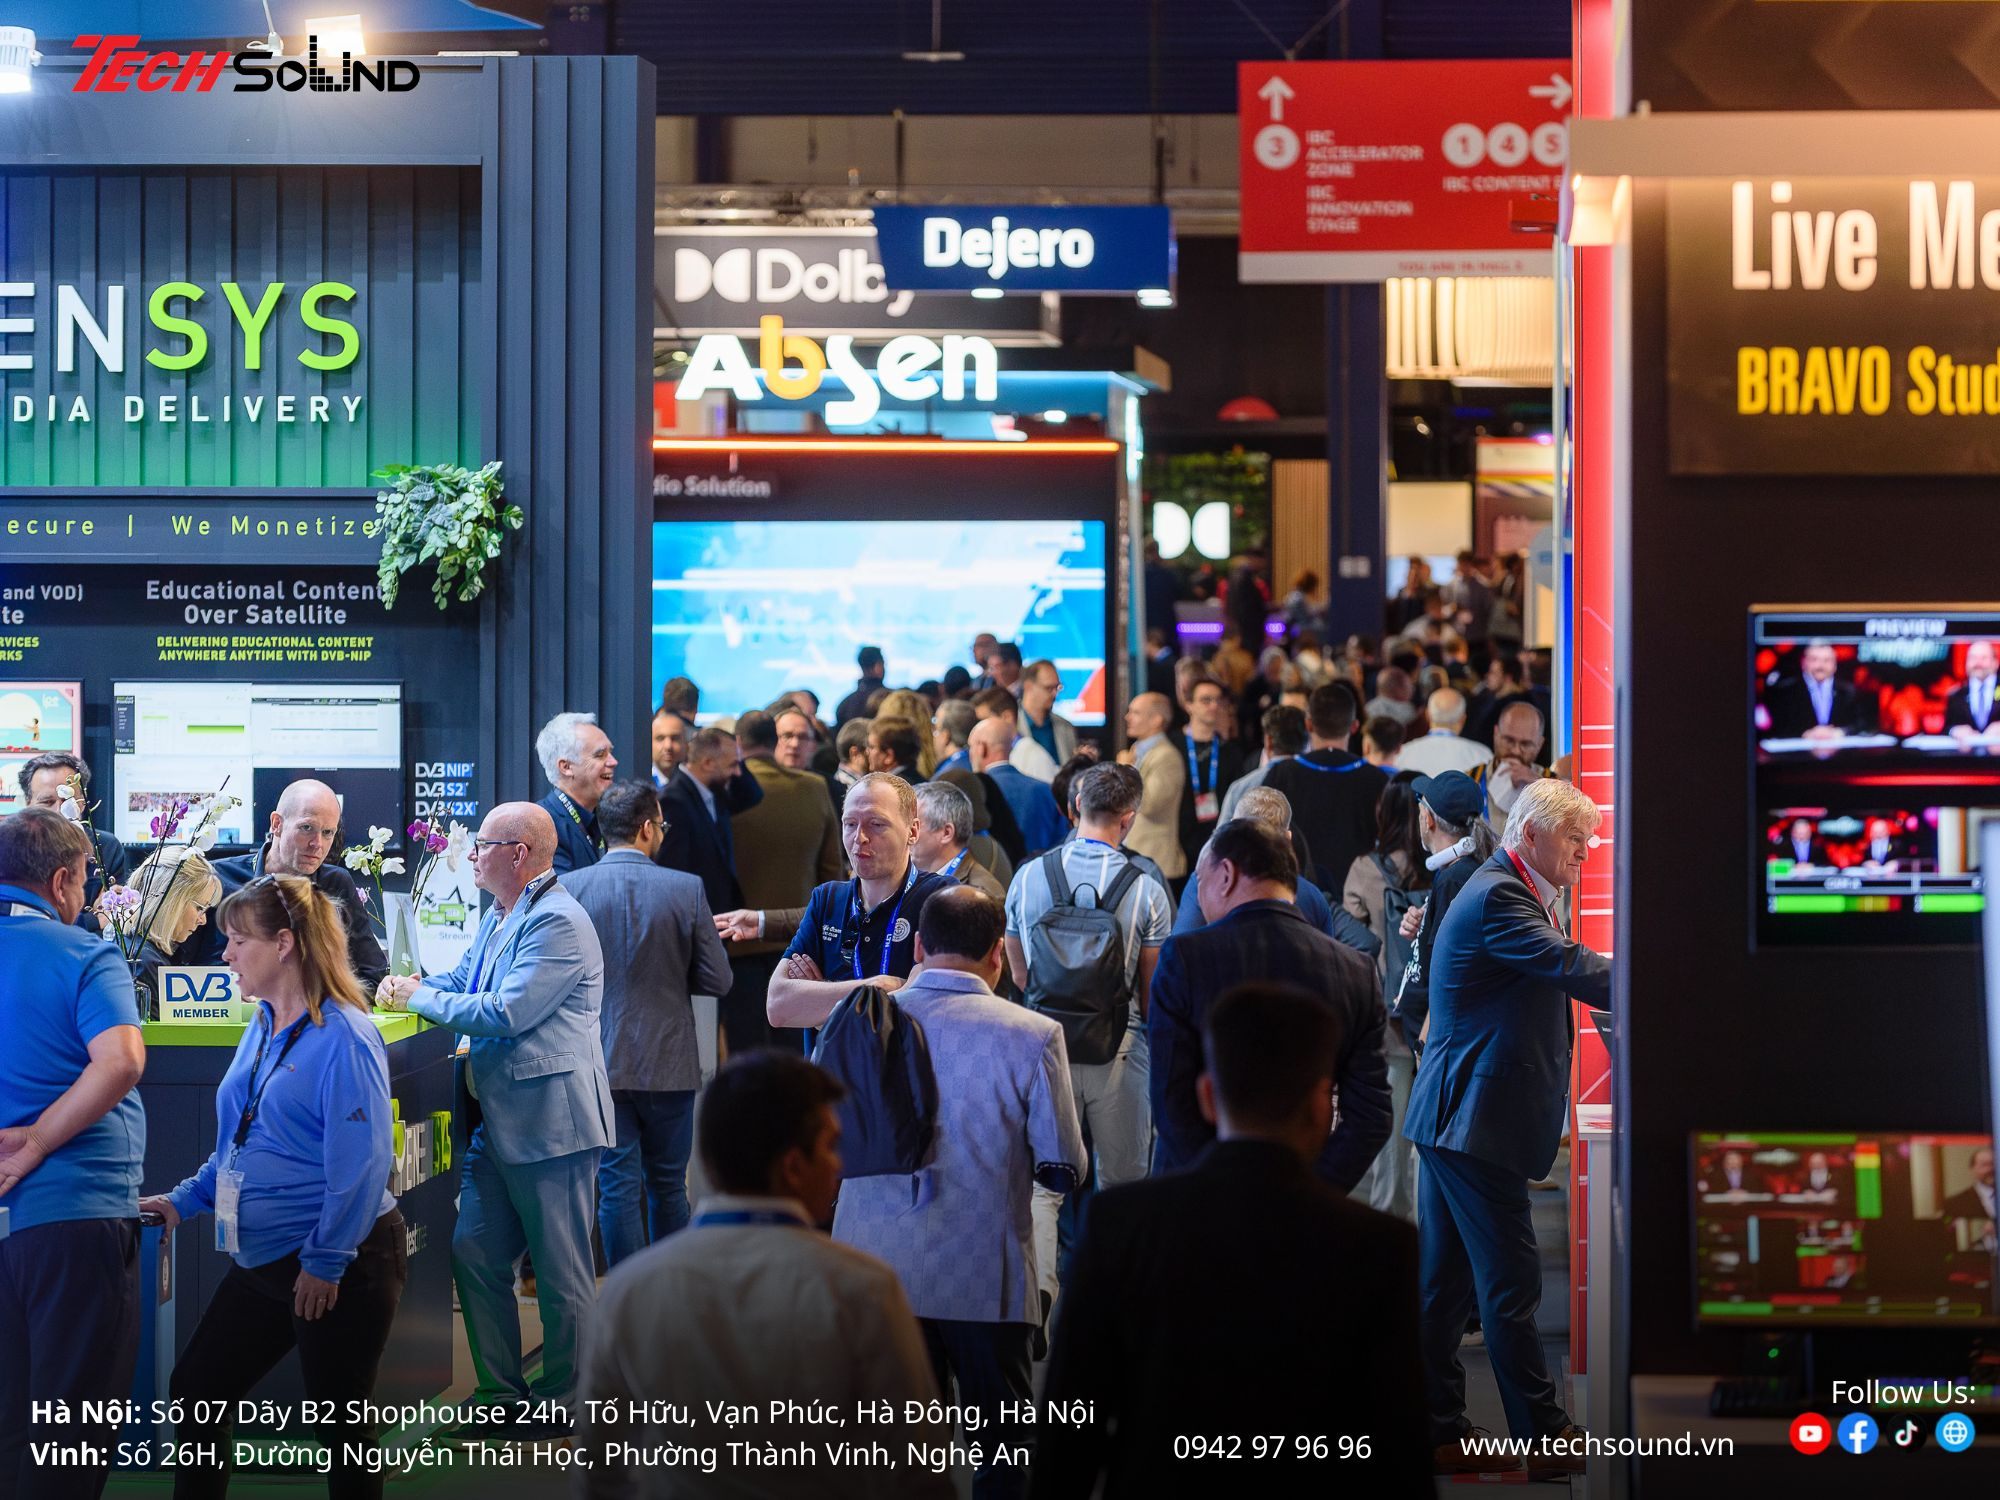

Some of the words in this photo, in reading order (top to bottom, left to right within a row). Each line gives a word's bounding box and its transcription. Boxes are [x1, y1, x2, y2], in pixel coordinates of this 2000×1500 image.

[1305, 130, 1335, 145] IBC
[1306, 145, 1424, 161] ACCELERATOR
[1306, 162, 1354, 178] ZONE
[1306, 185, 1335, 200] IBC
[1442, 176, 1471, 192] IBC
[1472, 175, 1551, 192] CONTENT
[1306, 201, 1414, 216] INNOVATION
[1732, 180, 1877, 292] Live
[923, 215, 1095, 280] Dejero
[674, 314, 999, 426] Absen
[1737, 345, 1891, 416] BRAVO
[14, 395, 91, 423] DIA
[124, 395, 362, 423] DELIVERY
[684, 474, 771, 498] Solution
[7, 519, 95, 535] ecure
[171, 515, 211, 536] We
[231, 515, 374, 536] Monetize
[3, 585, 35, 600] and
[41, 585, 83, 602] VOD)
[146, 580, 285, 600] Educational
[2, 606, 25, 625] te
[185, 605, 238, 625] Over
[246, 605, 347, 625] Satellite
[157, 636, 229, 648] DELIVERING
[231, 636, 315, 648] EDUCATIONAL
[317, 636, 373, 648] CONTENT
[159, 649, 226, 661] ANYWHERE
[229, 649, 283, 661] ANYTIME
[287, 649, 318, 661] WITH
[321, 649, 372, 661] DVB-NIP
[165, 973, 233, 1002] DVB
[173, 1009, 230, 1018] MEMBER
